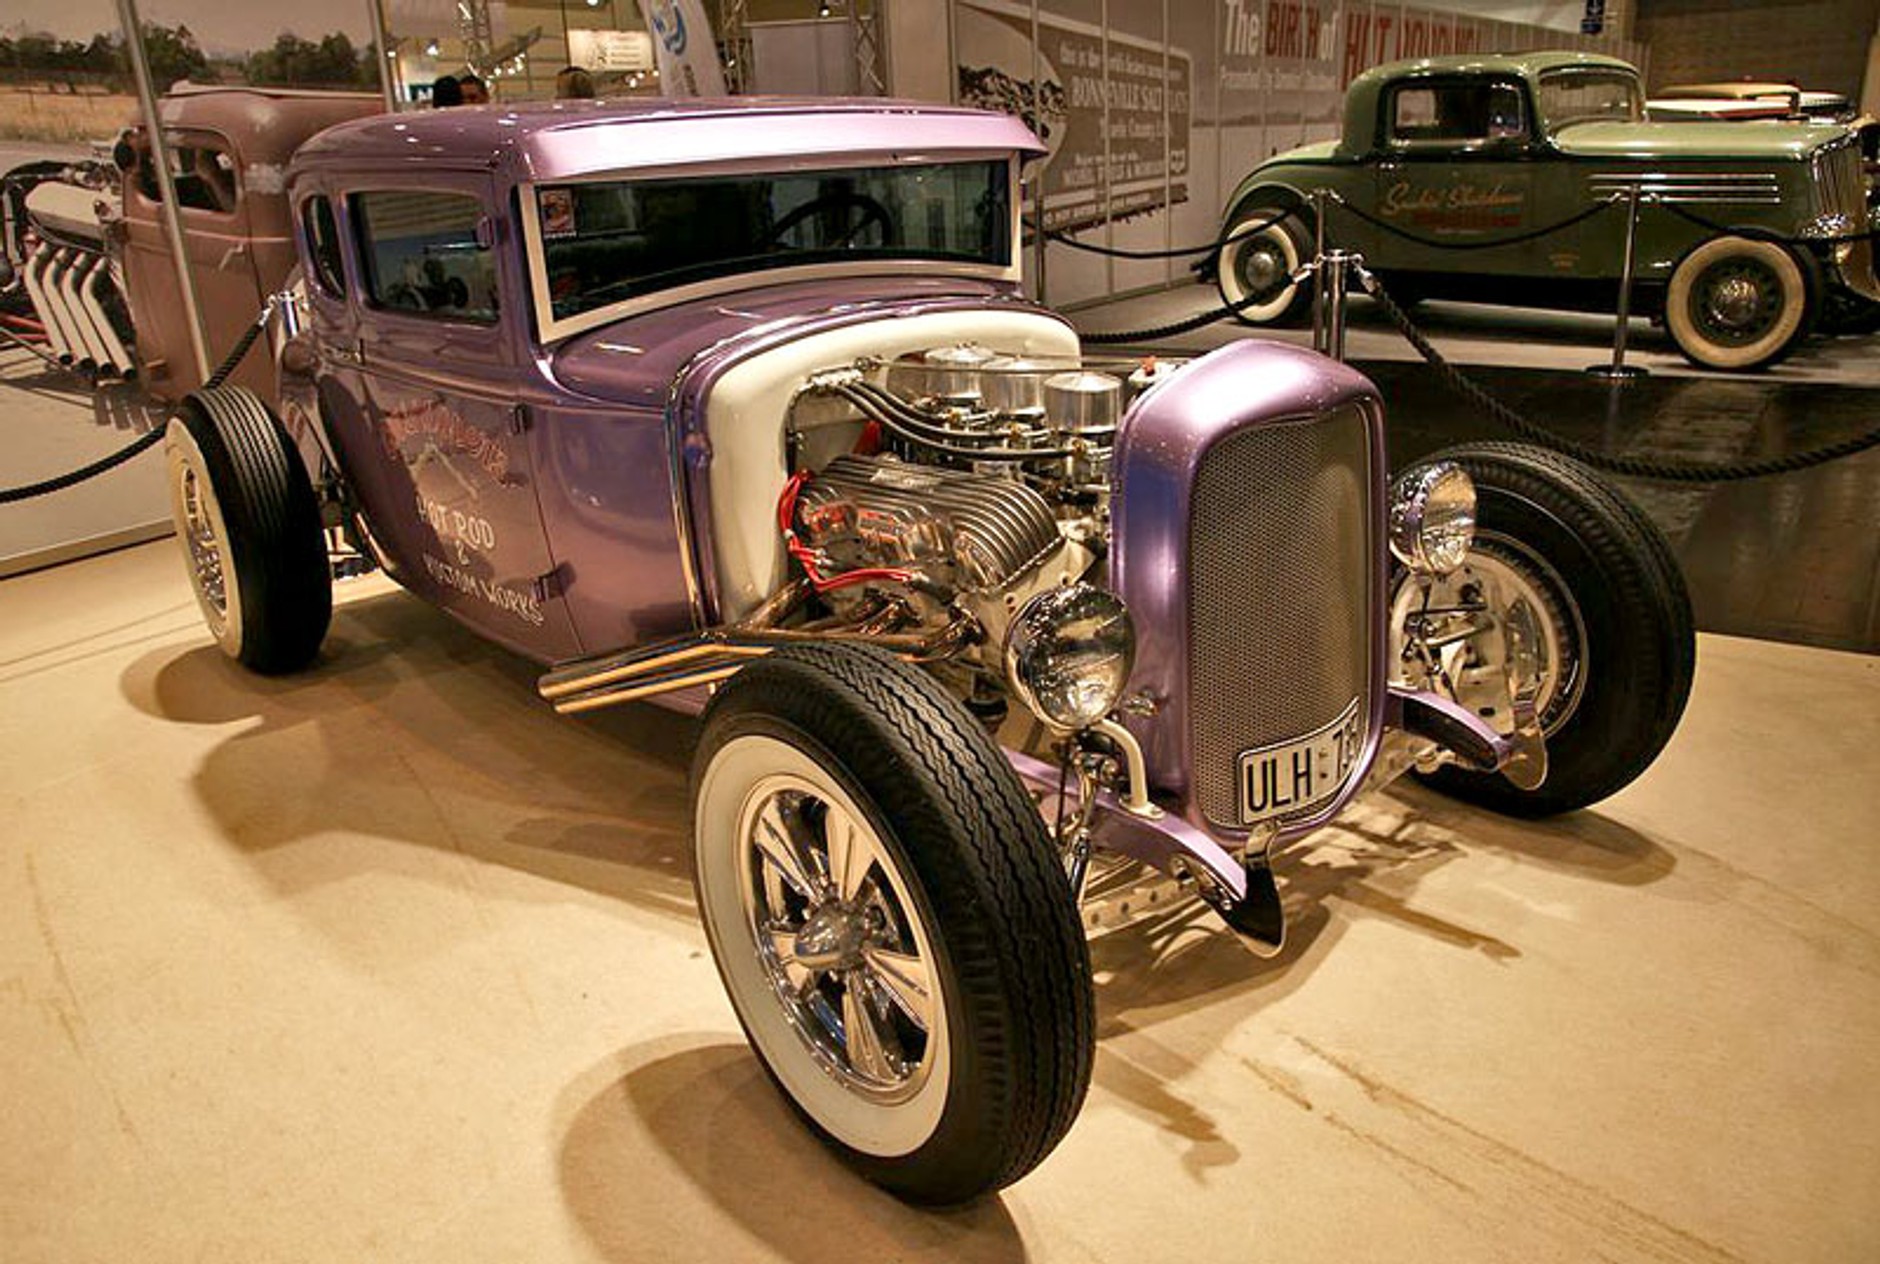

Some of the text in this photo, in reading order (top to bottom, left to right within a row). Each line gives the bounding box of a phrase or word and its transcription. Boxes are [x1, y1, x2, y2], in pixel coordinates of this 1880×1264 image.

[1225, 0, 1259, 56] The
[1319, 11, 1339, 61] of
[416, 496, 495, 550] HOT ROD
[1246, 748, 1311, 812] ULH
